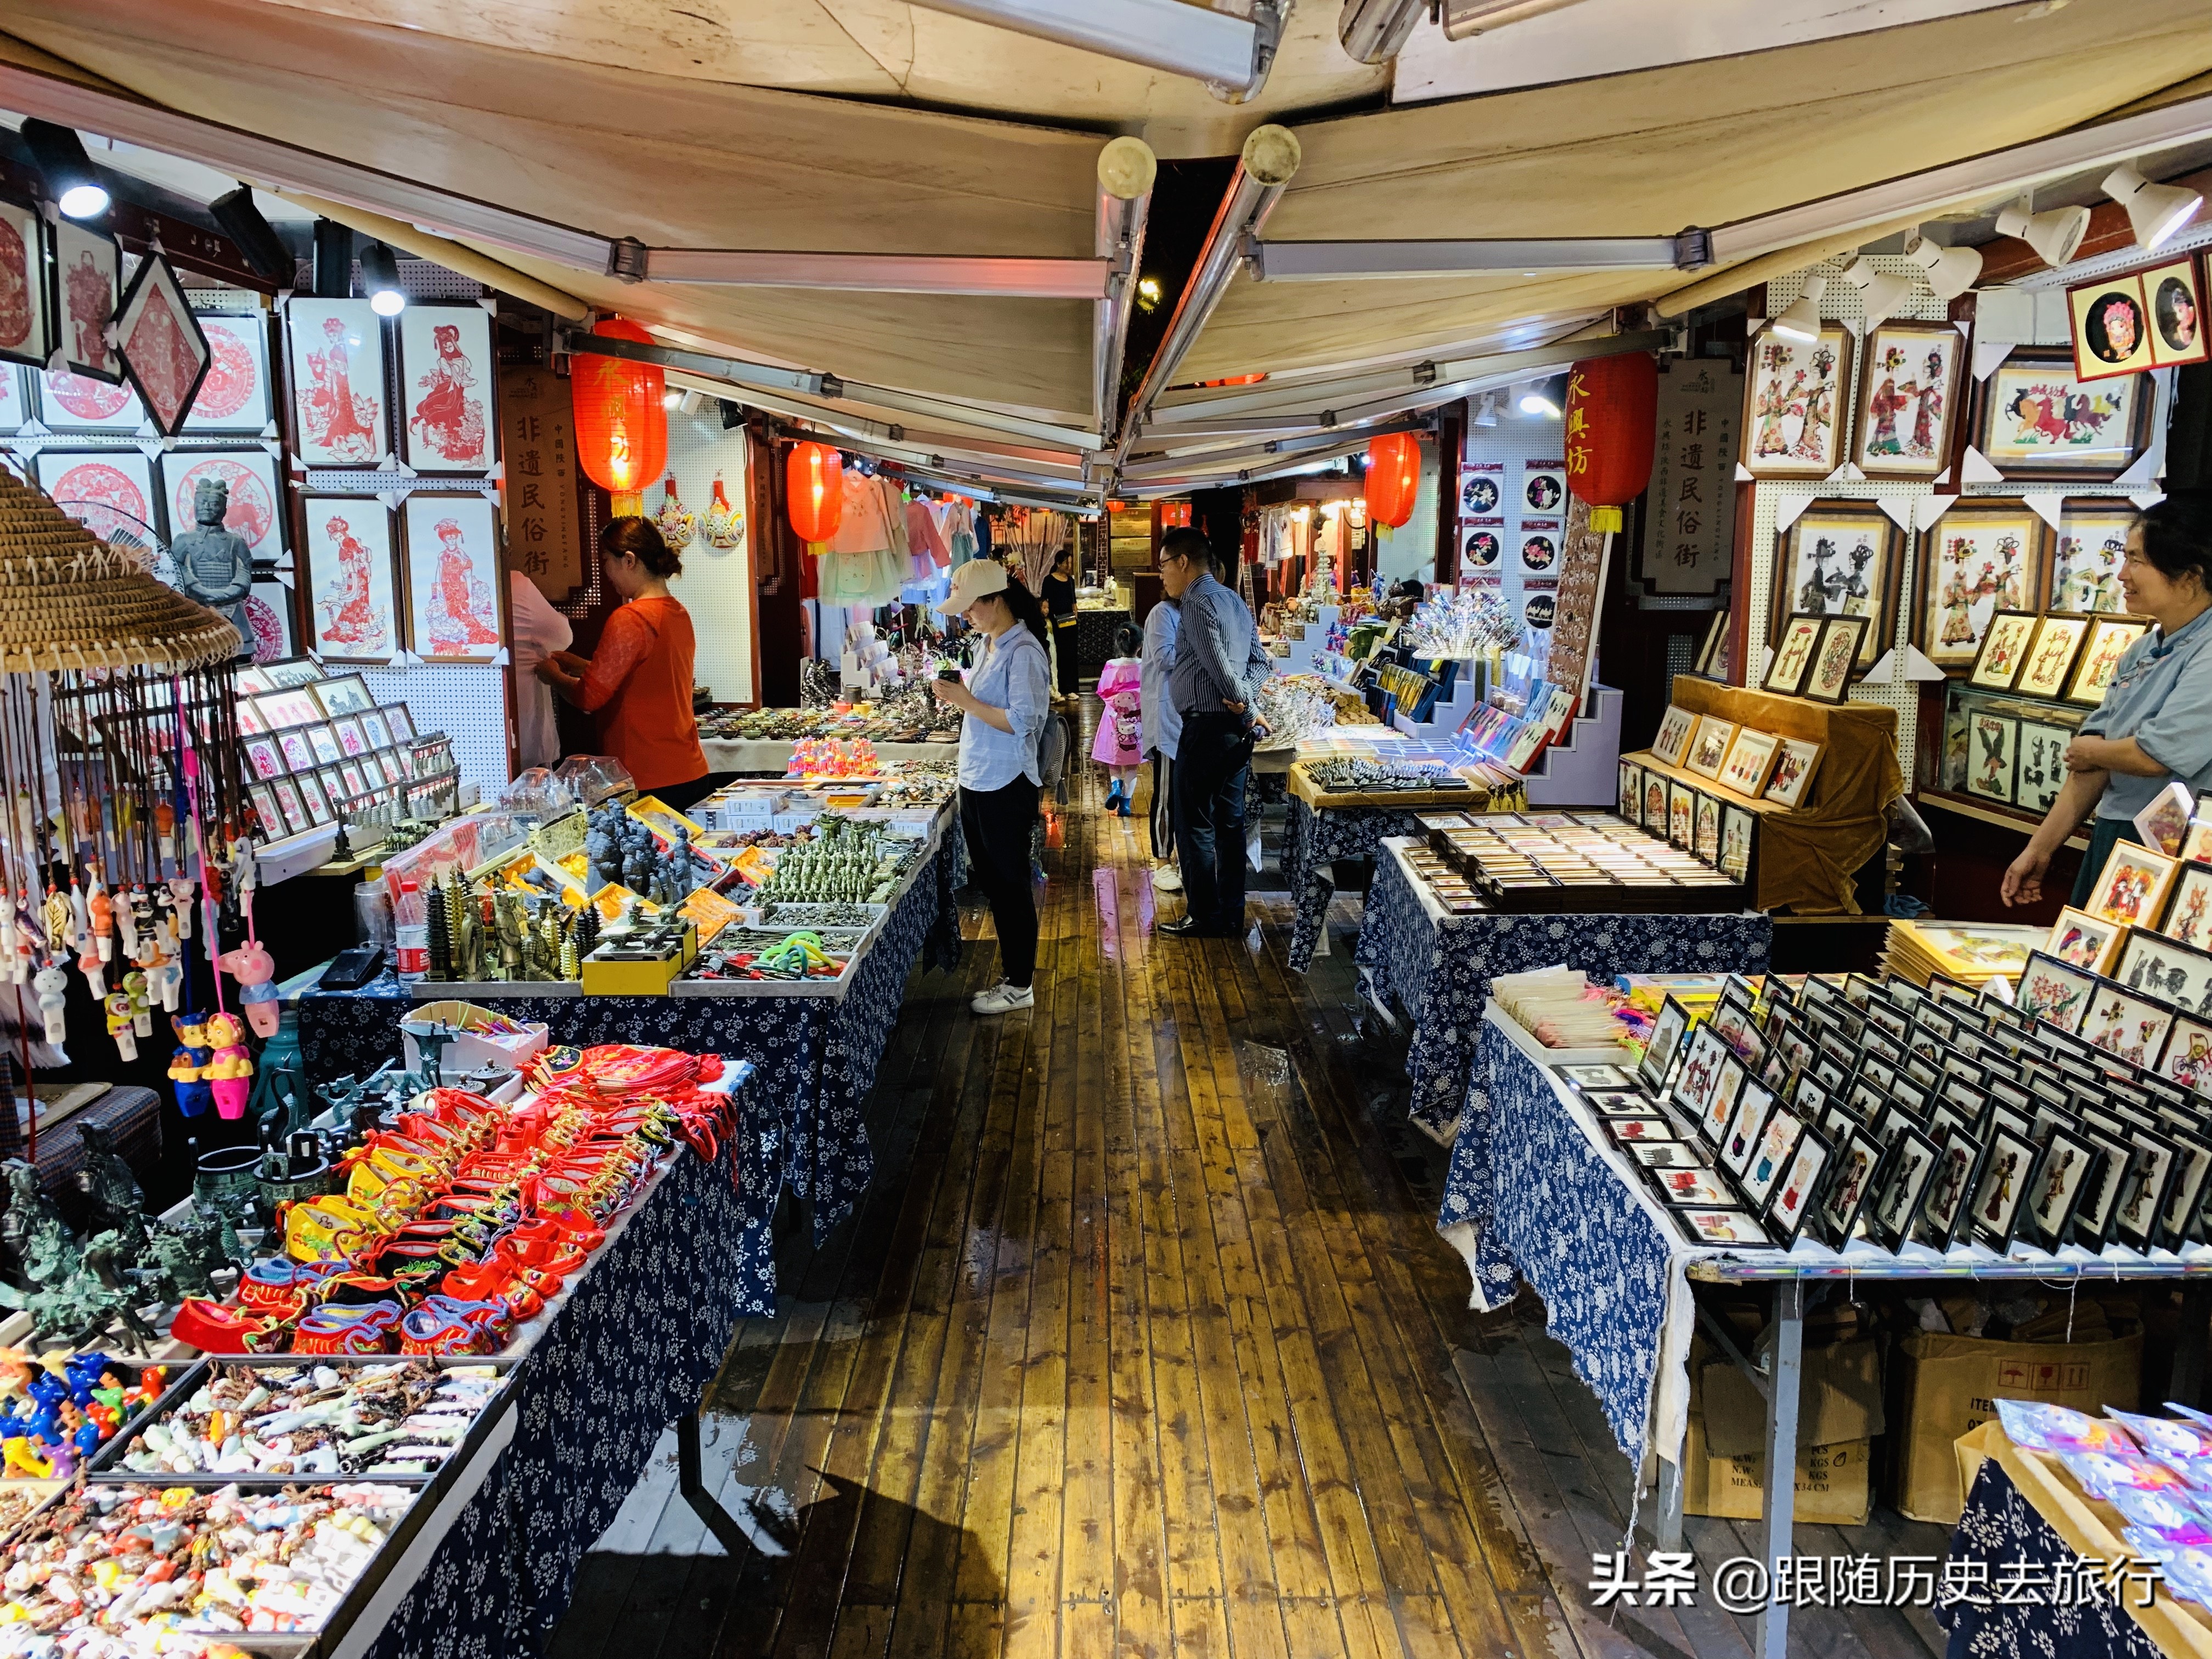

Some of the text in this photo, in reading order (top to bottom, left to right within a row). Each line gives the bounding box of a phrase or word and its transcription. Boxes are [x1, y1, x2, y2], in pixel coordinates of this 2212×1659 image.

[1566, 369, 1593, 476] 永興坊
[517, 415, 550, 575] 非遗民俗街
[1674, 409, 1707, 568] 非遗民俗街
[1808, 1470, 1829, 1480] KGS
[1810, 1458, 1830, 1468] KGS
